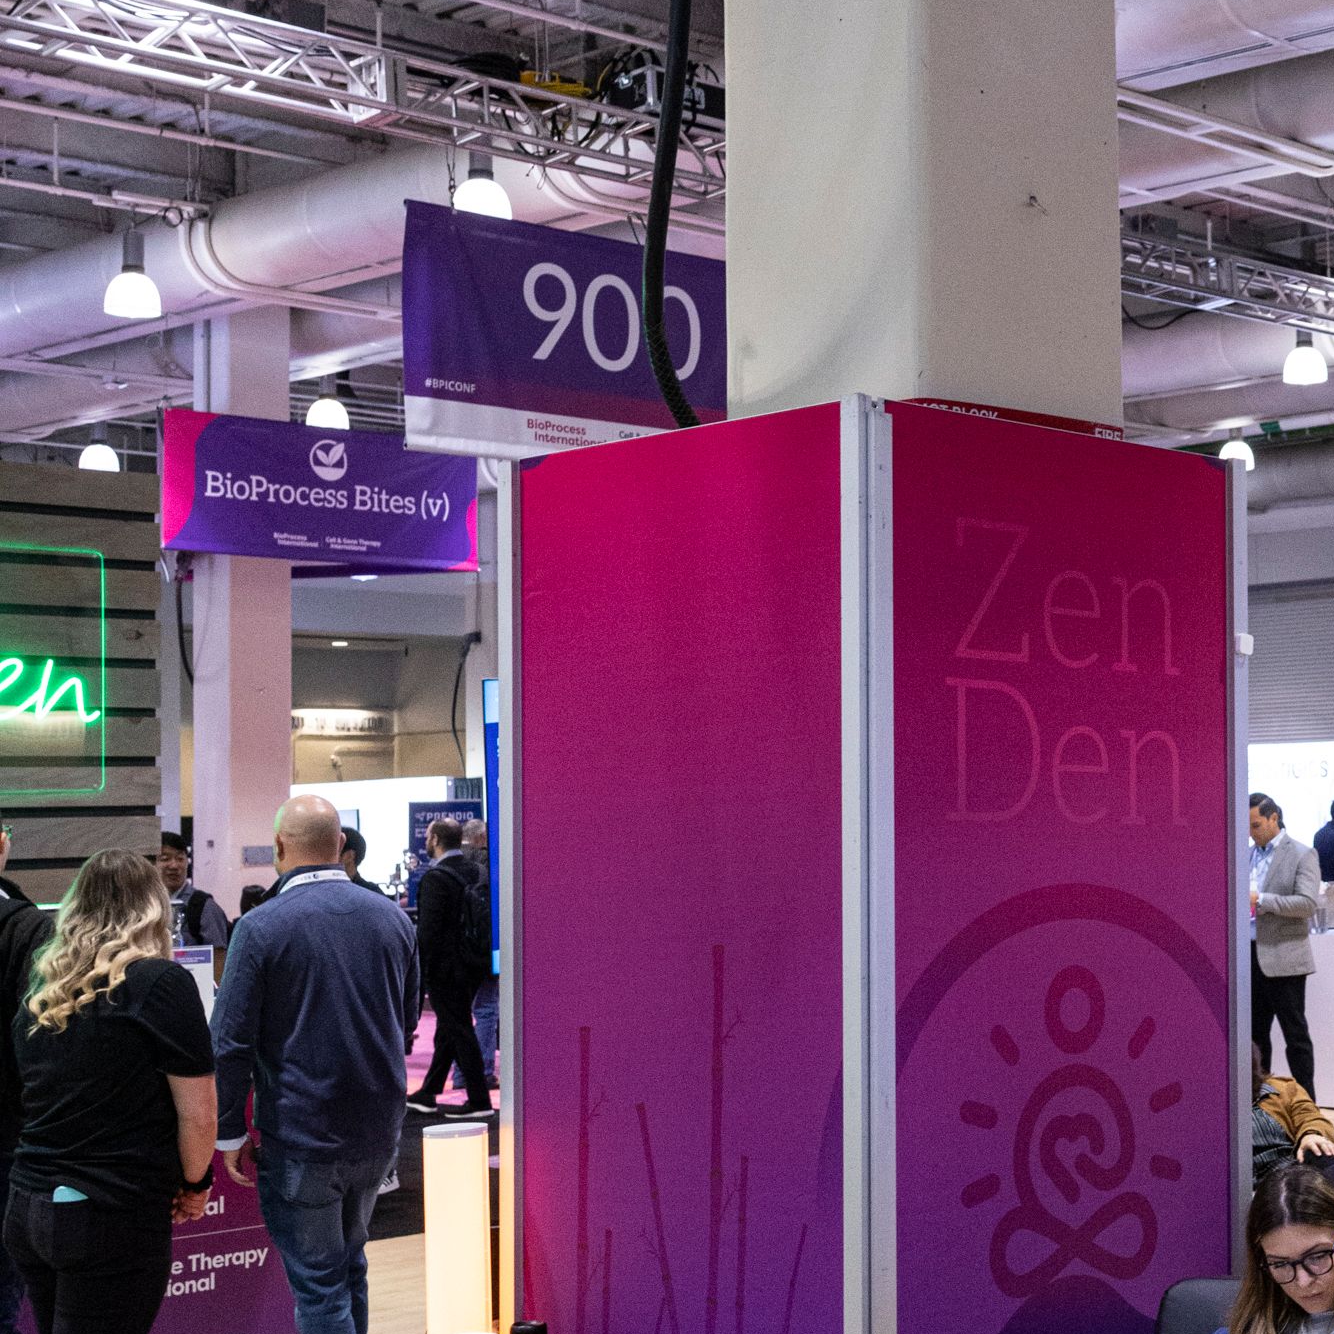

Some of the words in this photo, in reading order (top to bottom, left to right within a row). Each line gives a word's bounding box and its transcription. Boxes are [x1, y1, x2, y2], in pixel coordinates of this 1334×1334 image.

[522, 262, 702, 382] 900
[424, 376, 477, 395] #BPICONF
[526, 418, 587, 436] BioProcess
[533, 432, 608, 448] Internation
[204, 470, 348, 510] BioProcess
[353, 485, 416, 515] Bites
[420, 490, 451, 522] (v)
[955, 517, 1183, 676] Zen
[945, 675, 1189, 827] Den
[187, 1247, 269, 1272] Therapy
